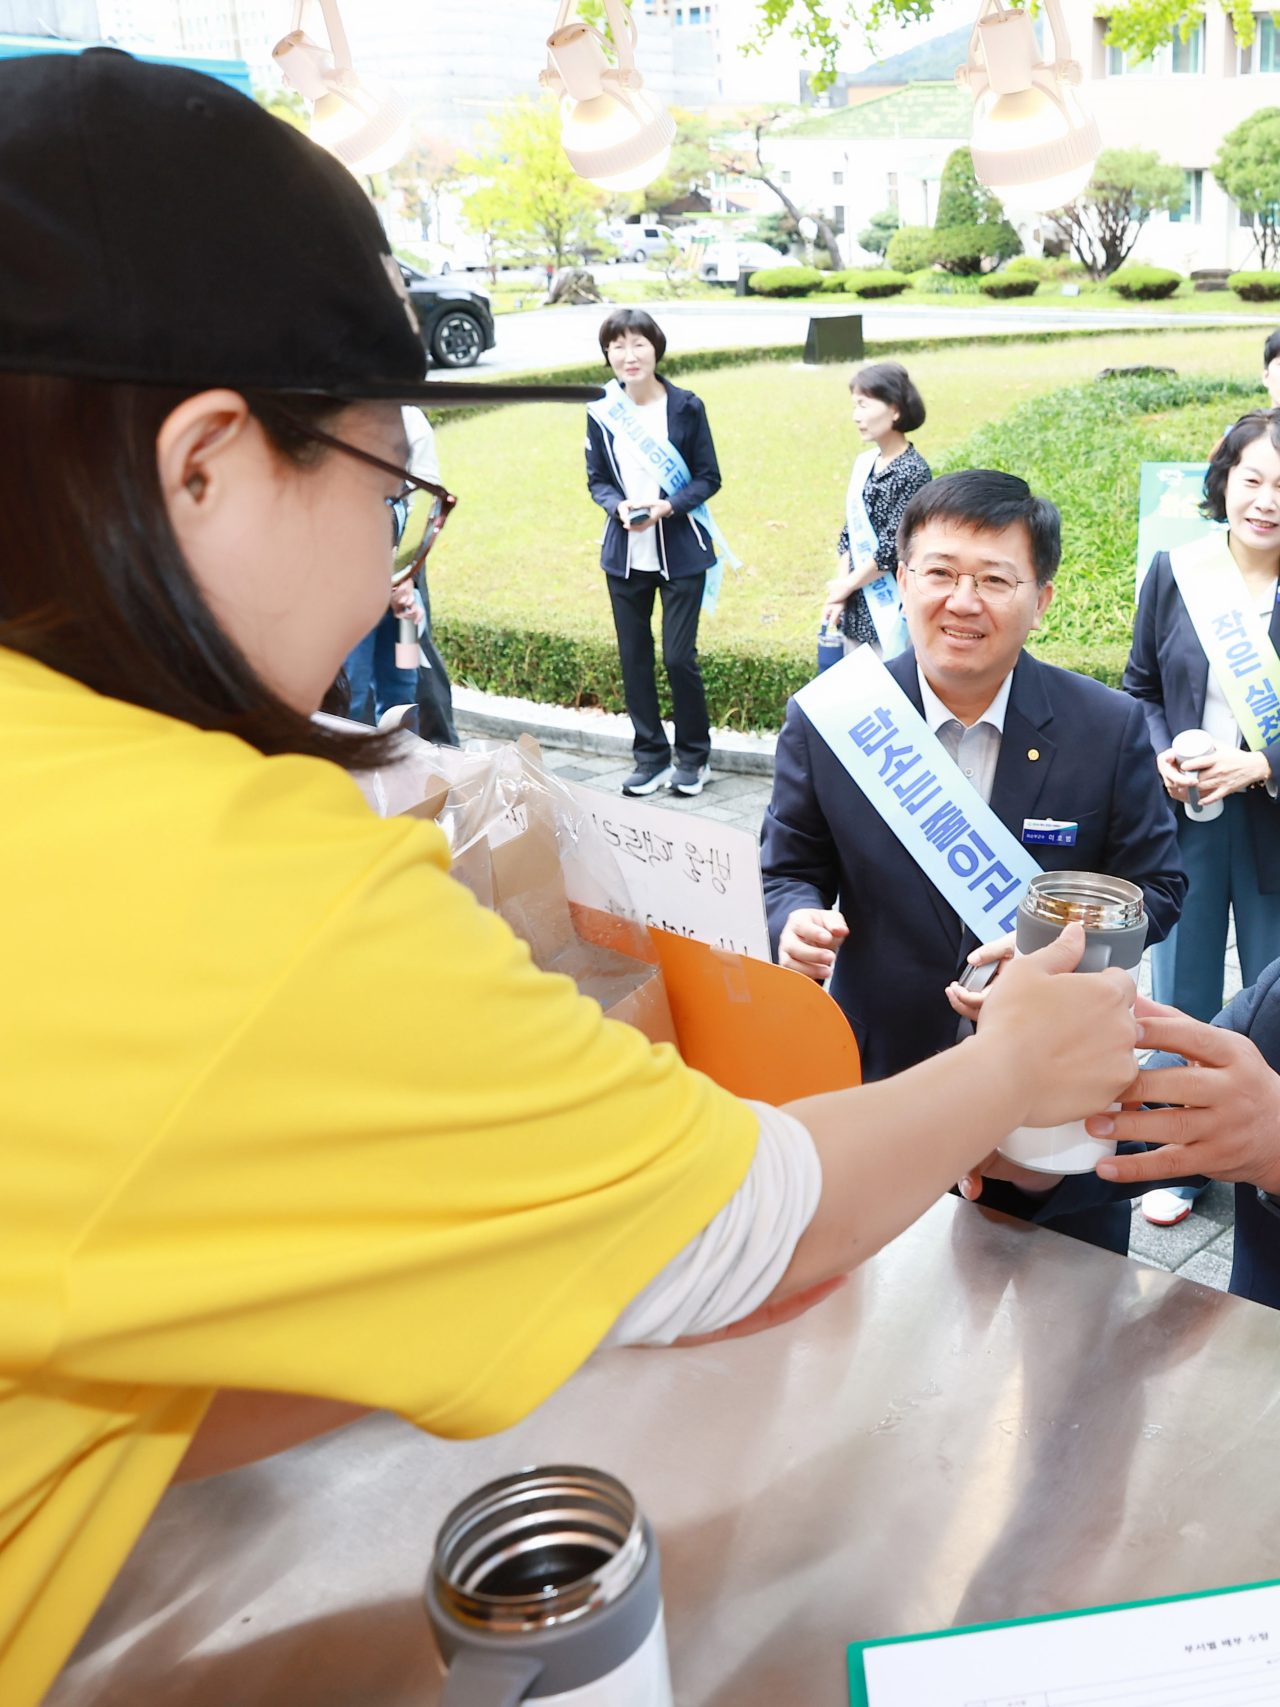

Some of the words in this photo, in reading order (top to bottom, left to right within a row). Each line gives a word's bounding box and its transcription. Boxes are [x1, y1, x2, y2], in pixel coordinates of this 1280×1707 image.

[1211, 608, 1262, 679] 작은
[848, 706, 941, 816] 탄소는
[919, 800, 1022, 914] 줄이고
